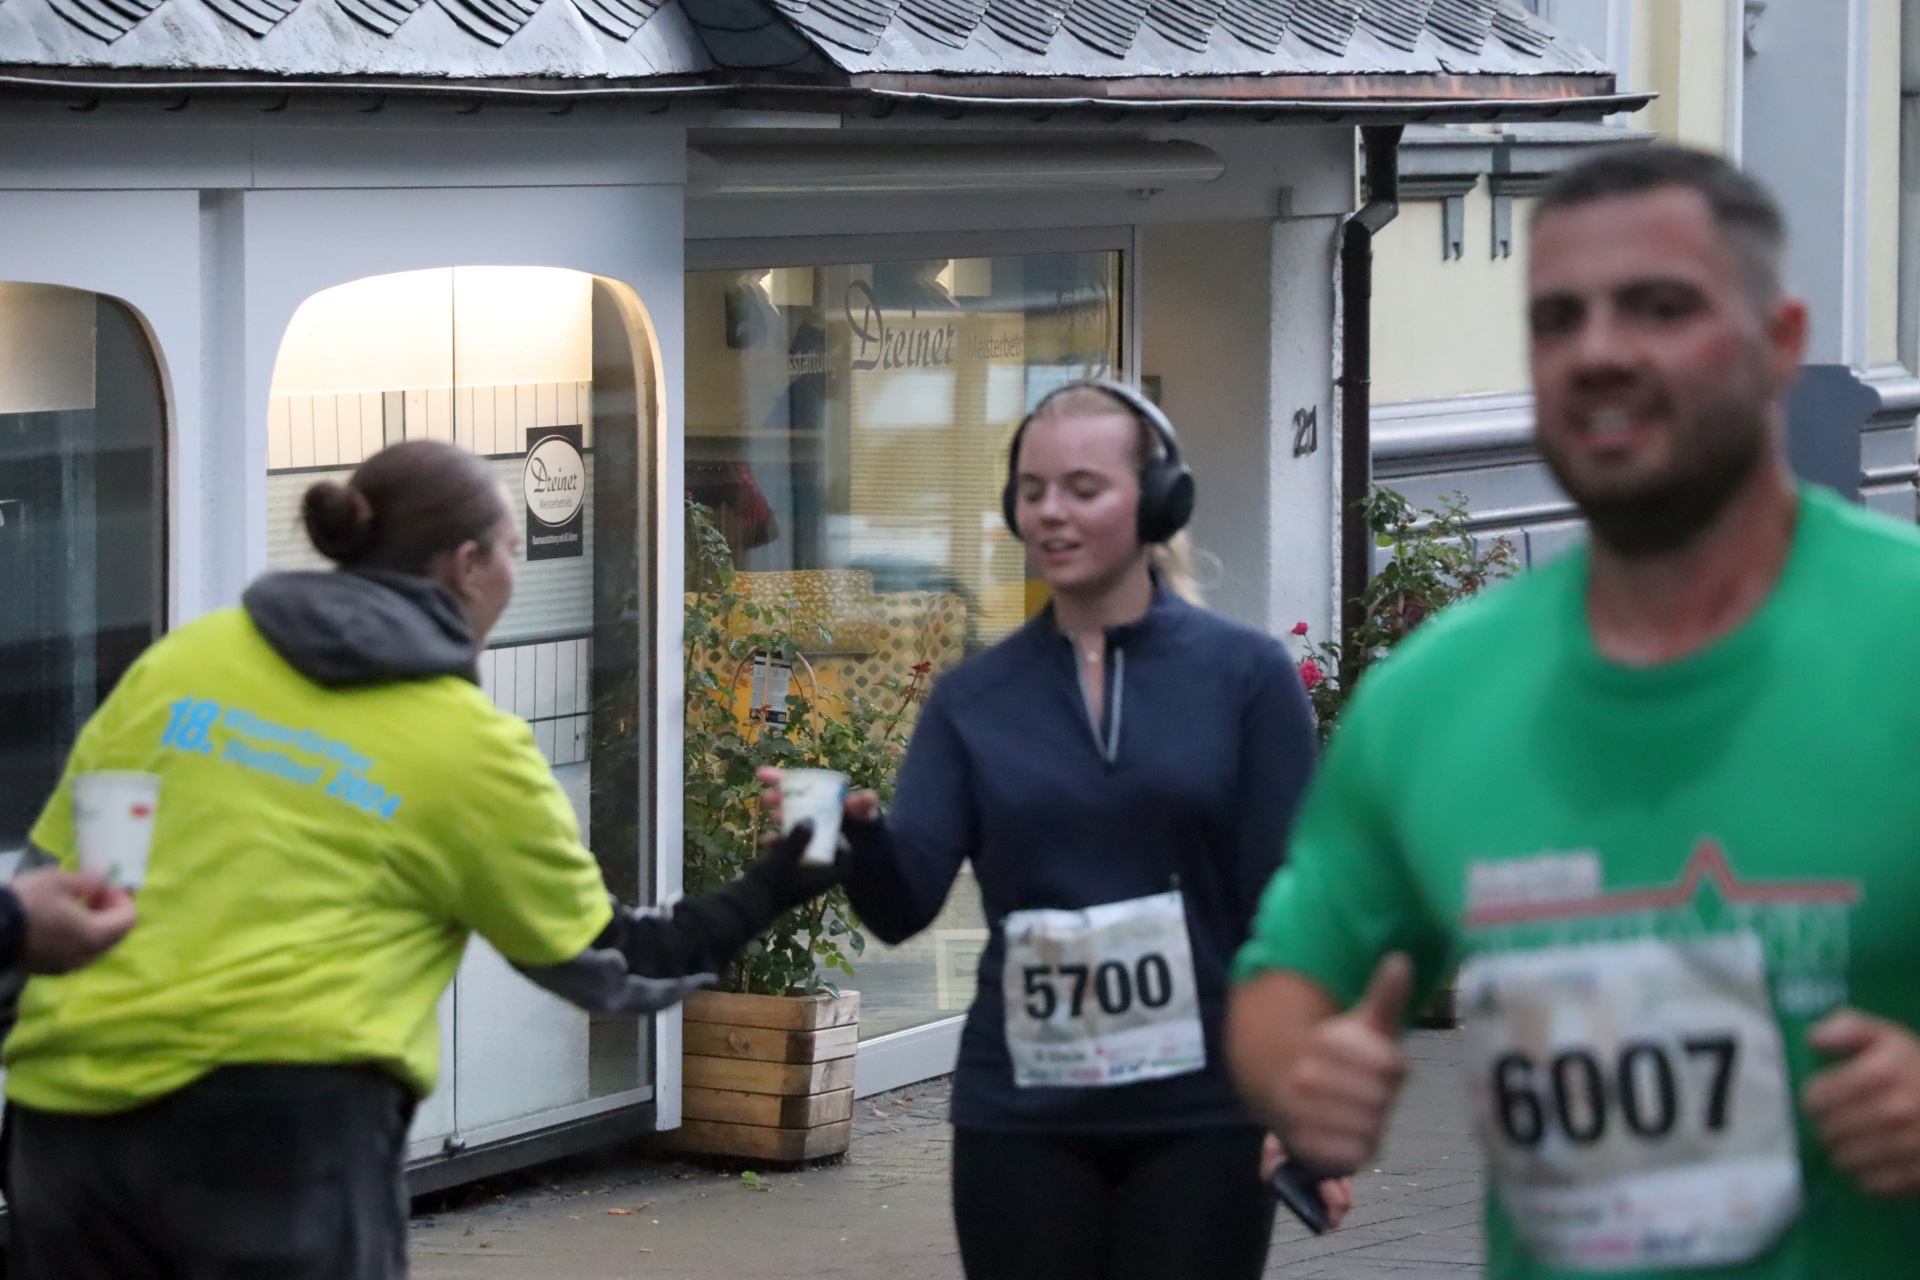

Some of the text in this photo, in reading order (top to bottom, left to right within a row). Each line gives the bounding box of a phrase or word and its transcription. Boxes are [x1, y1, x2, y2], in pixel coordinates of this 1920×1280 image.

[845, 280, 954, 370] Dreiner
[1292, 405, 1318, 458] 21
[531, 457, 577, 493] Dreiner
[160, 696, 221, 755] 18.
[1023, 953, 1172, 1020] 5700
[1491, 1032, 1740, 1147] 6007
